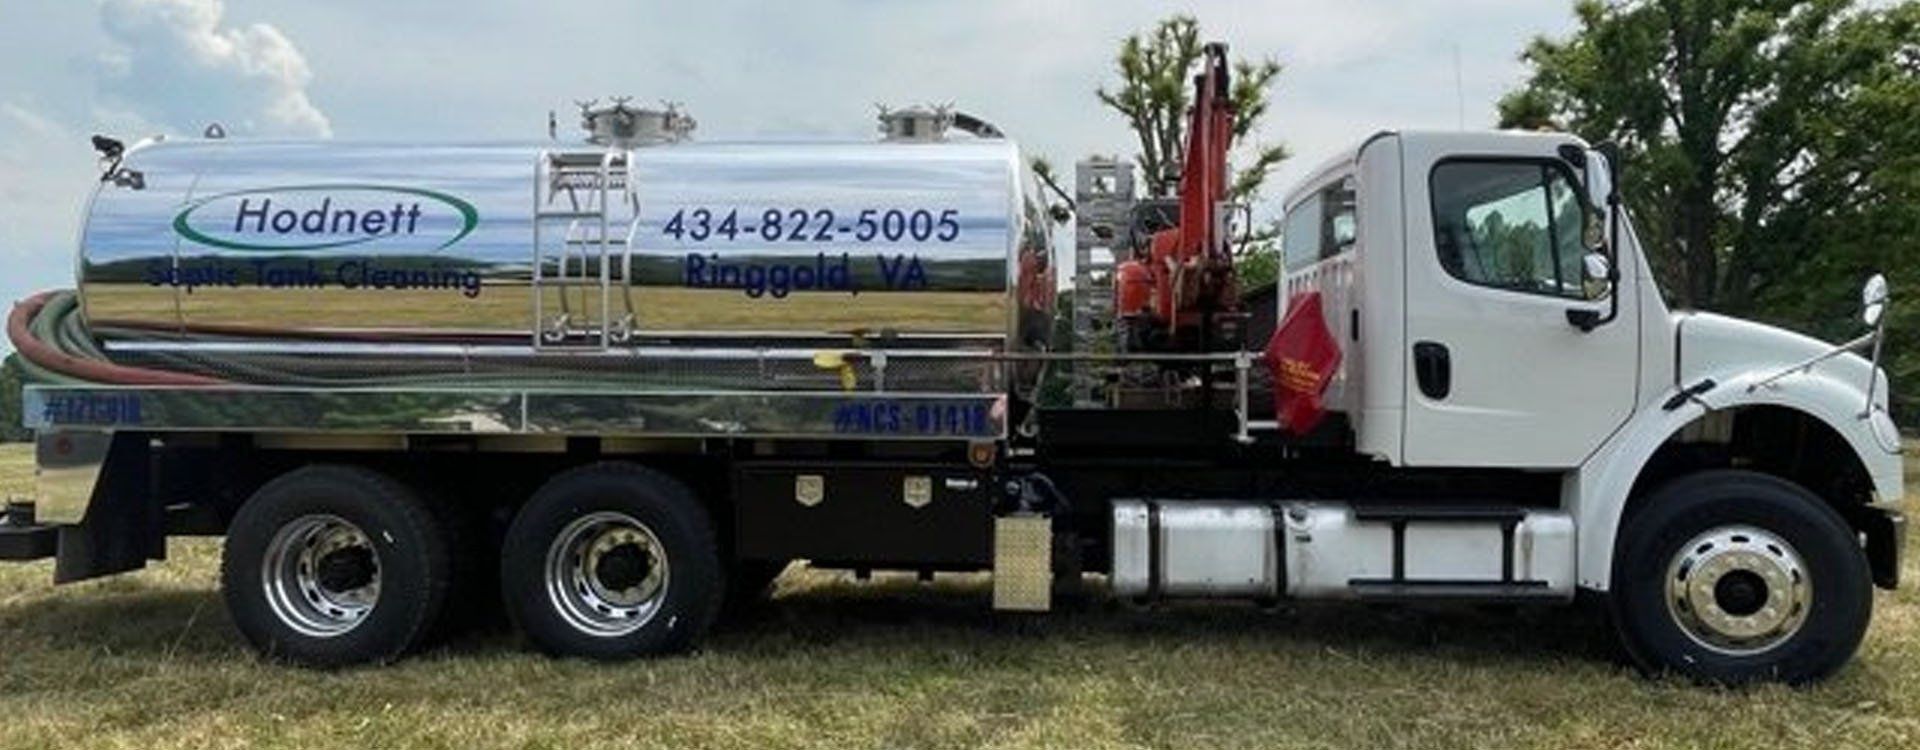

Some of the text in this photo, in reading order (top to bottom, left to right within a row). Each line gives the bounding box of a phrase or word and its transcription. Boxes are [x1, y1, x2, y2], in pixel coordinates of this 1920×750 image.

[233, 197, 421, 235] Hodnett
[663, 208, 960, 242] 434-822-5005
[146, 257, 481, 299] Septic Tank Cleaning
[684, 251, 928, 299] Ringgold, VA
